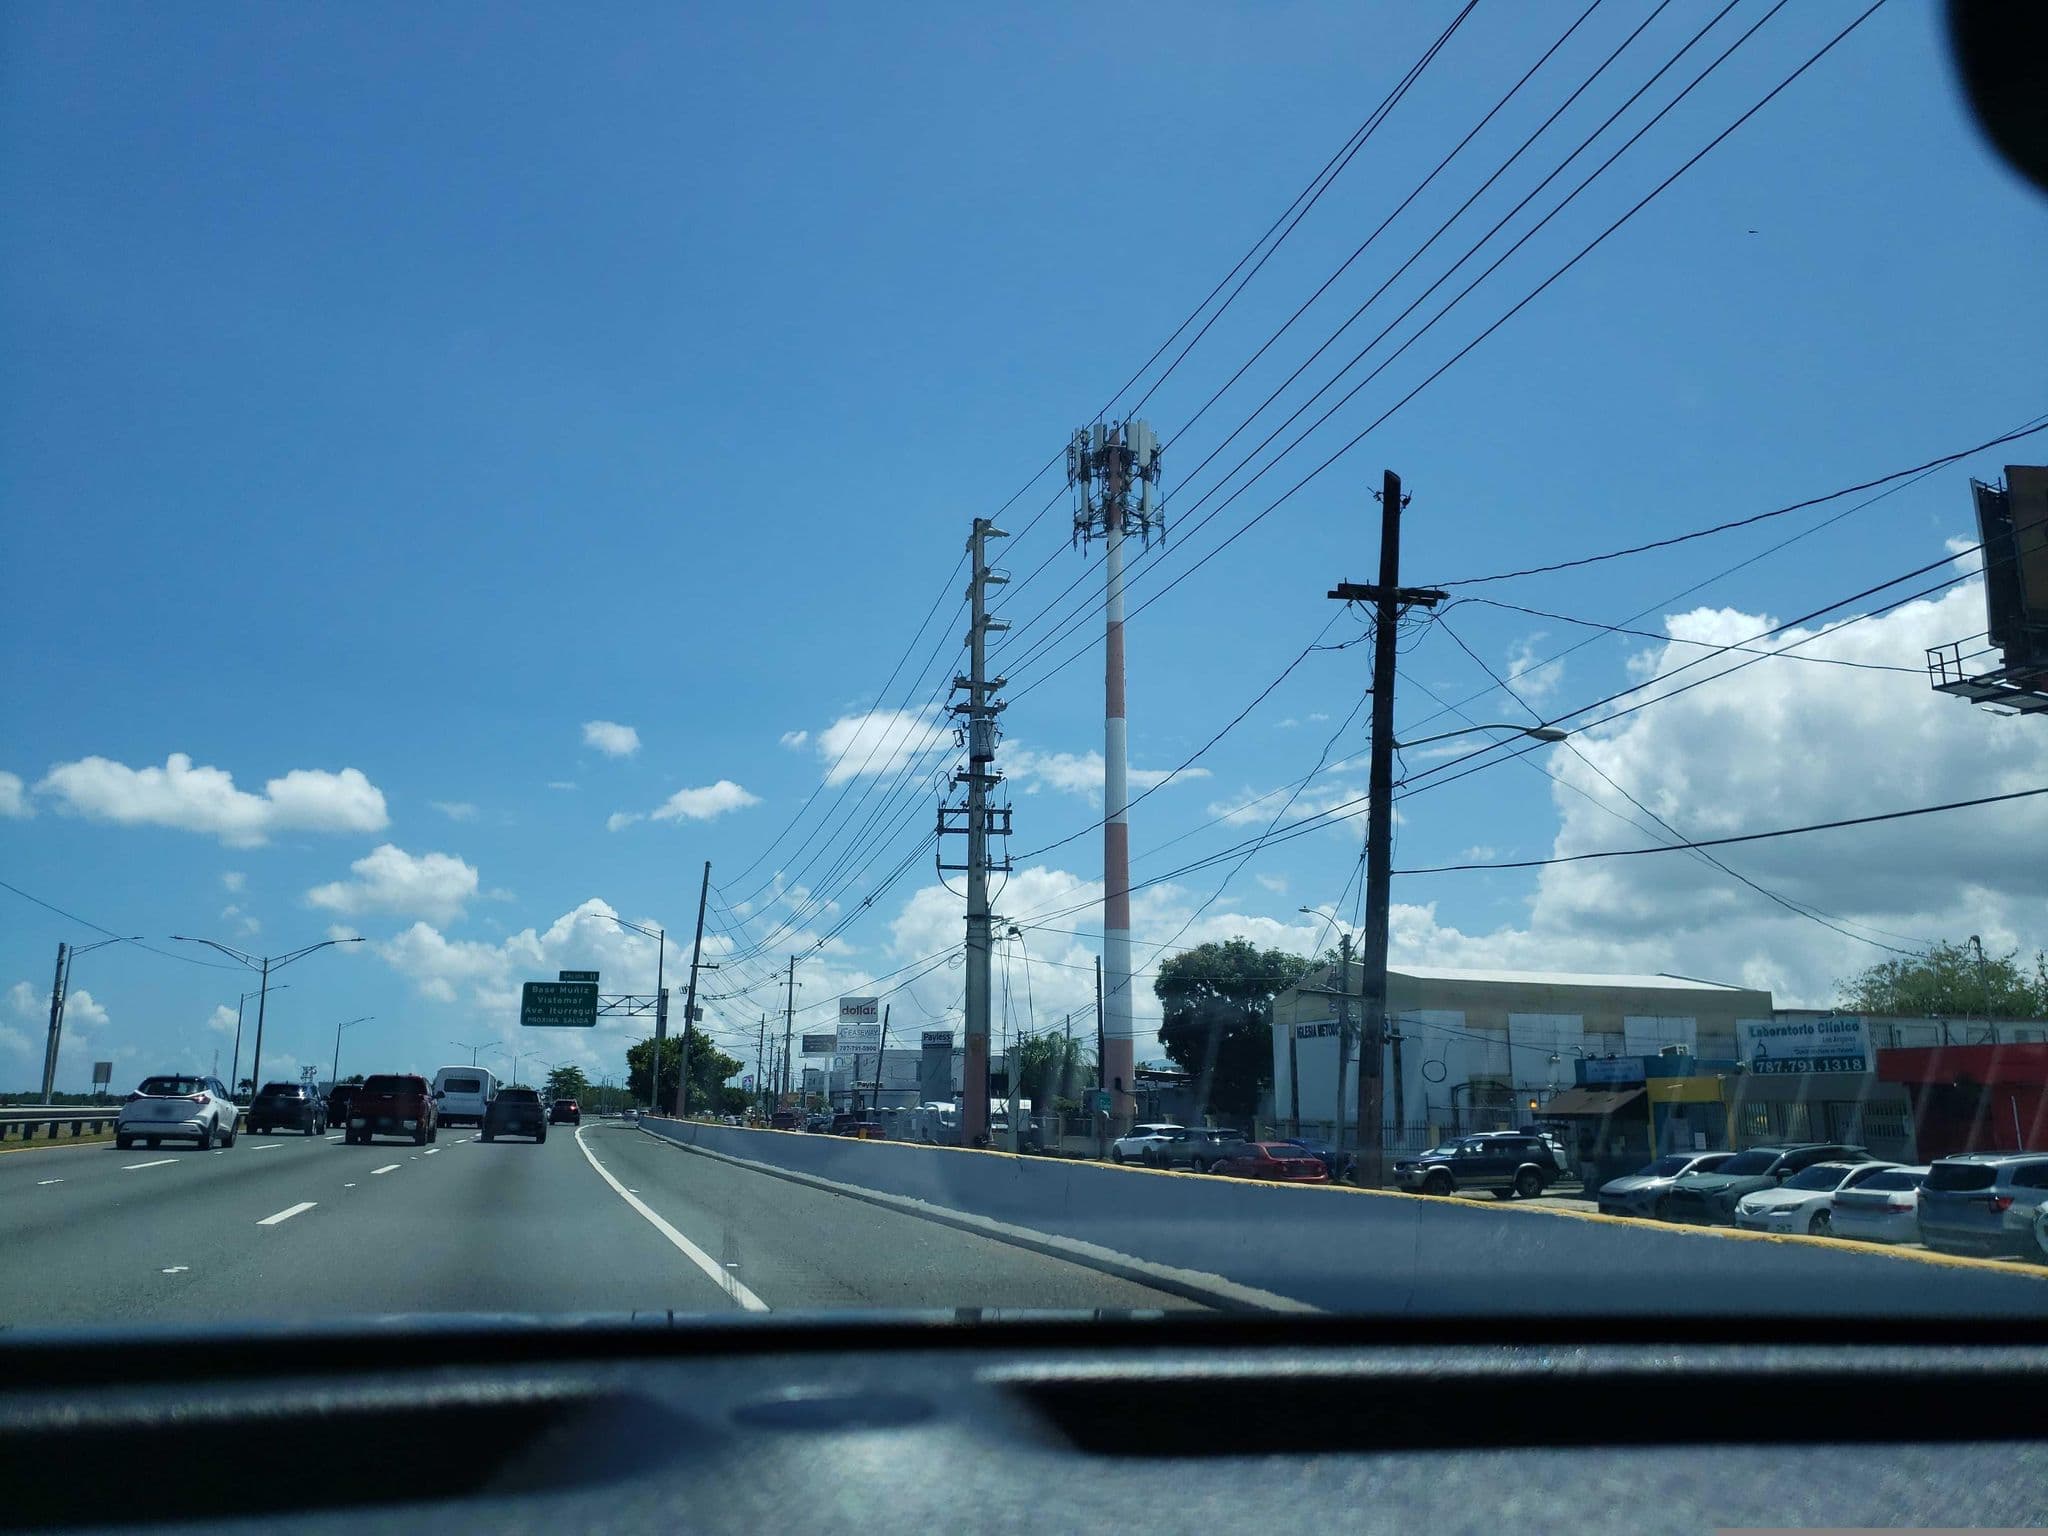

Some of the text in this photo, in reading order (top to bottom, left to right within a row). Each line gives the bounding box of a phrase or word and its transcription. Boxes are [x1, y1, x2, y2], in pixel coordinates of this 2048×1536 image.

[532, 985, 555, 993] Base
[923, 1032, 951, 1043] Payless
[1297, 1024, 1317, 1039] IGLESIA
[1750, 1023, 1814, 1038] Laboratorio
[1756, 1059, 1862, 1073] 787.791.1318
